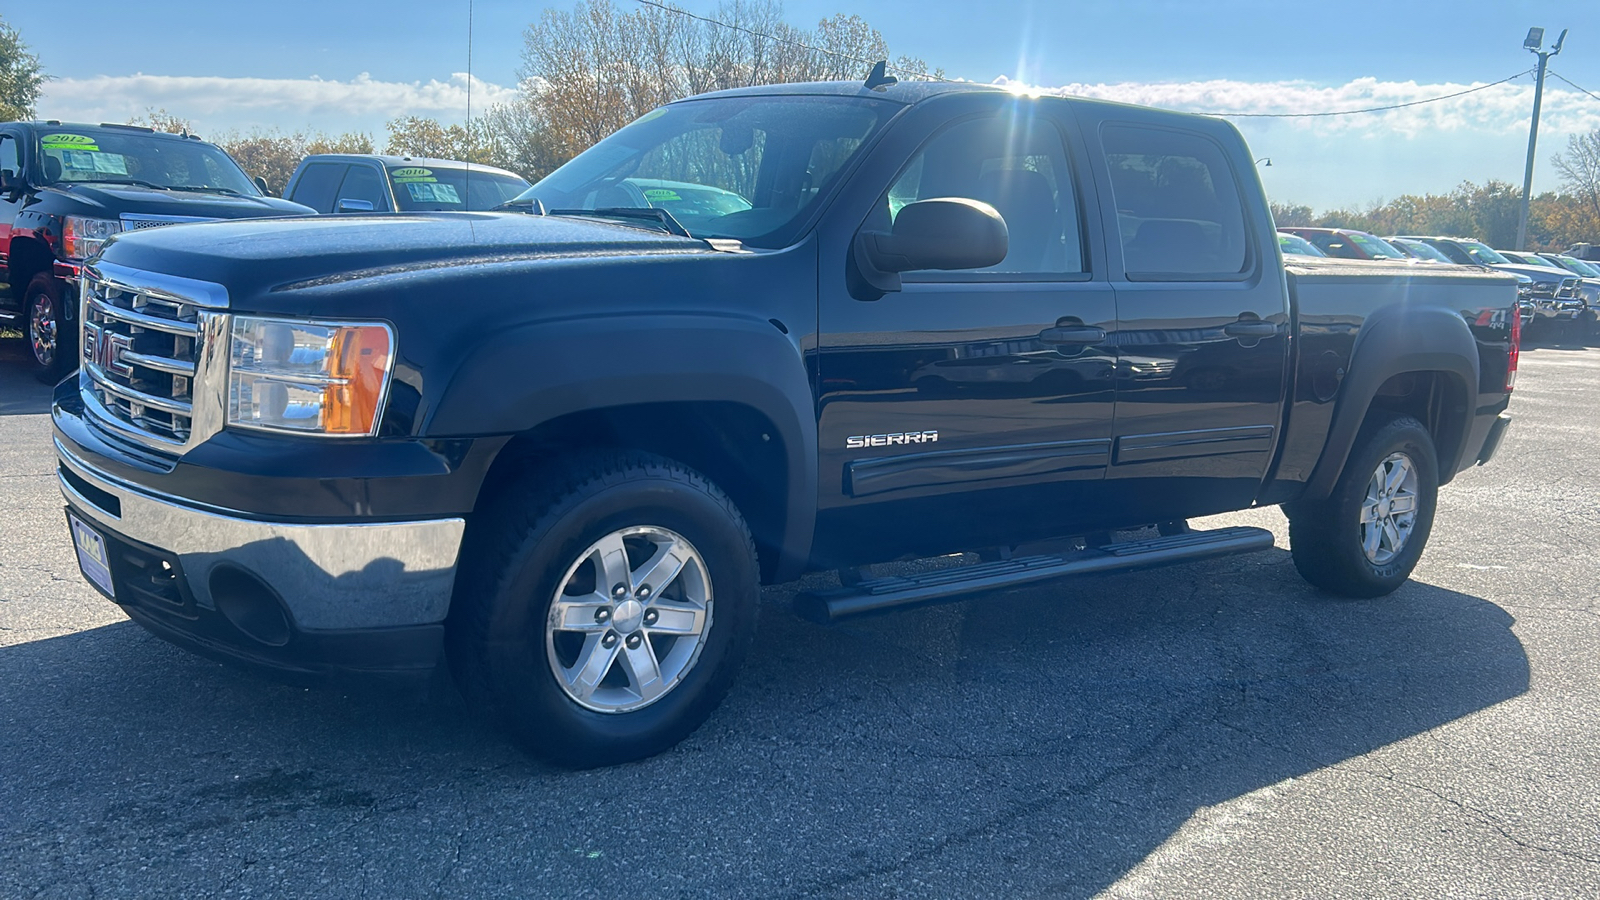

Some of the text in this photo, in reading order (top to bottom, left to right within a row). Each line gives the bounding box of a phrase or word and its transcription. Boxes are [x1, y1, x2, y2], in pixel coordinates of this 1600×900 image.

[52, 135, 86, 143] 2012
[1475, 307, 1506, 326] Z71
[84, 320, 135, 378] GMC
[846, 430, 938, 449] SIERRA
